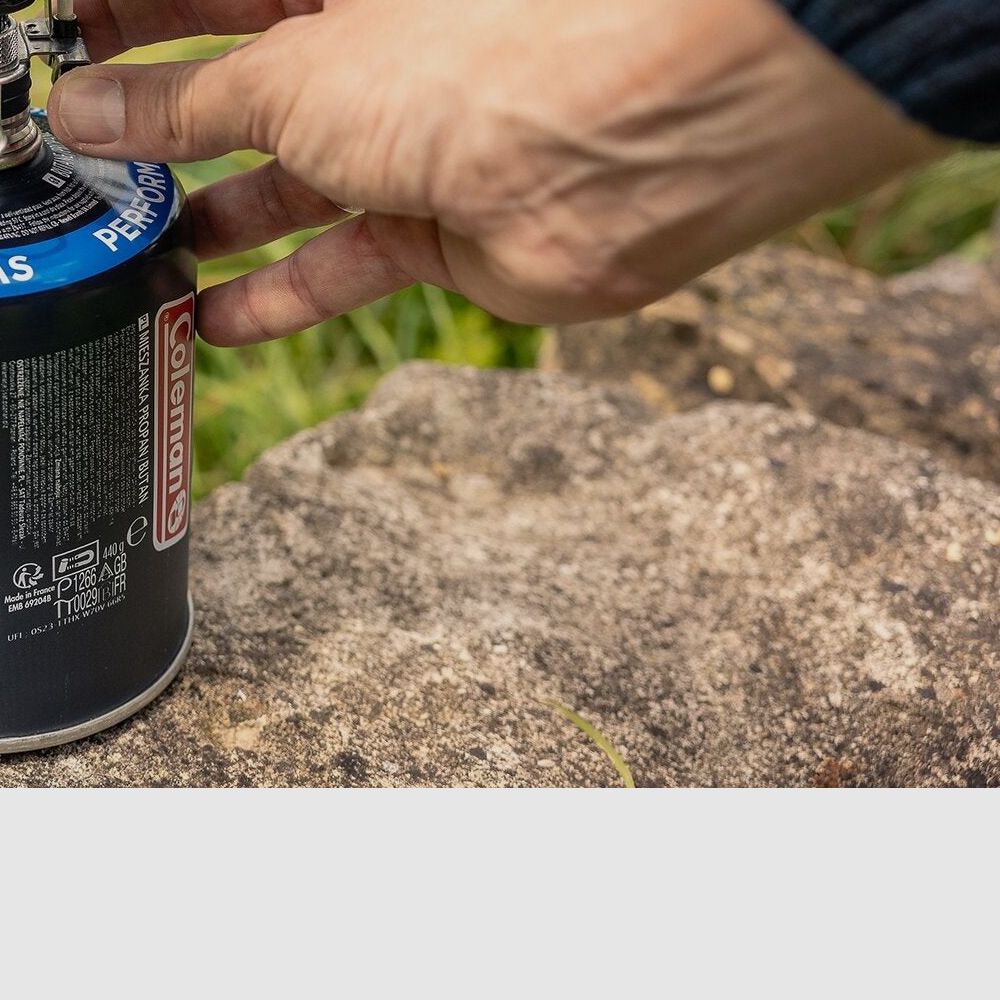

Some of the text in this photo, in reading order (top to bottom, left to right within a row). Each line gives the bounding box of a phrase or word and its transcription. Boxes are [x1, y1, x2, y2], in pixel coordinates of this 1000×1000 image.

[92, 161, 167, 252] PERFORM
[139, 330, 150, 405] MIESZANKA
[168, 311, 192, 494] Coleman
[137, 405, 150, 505] PROPAN/BUTAN
[102, 541, 125, 560] 440 g
[114, 552, 127, 575] GB
[4, 585, 56, 604] Made in France
[114, 572, 127, 597] FR
[8, 594, 52, 613] EMB 69204B
